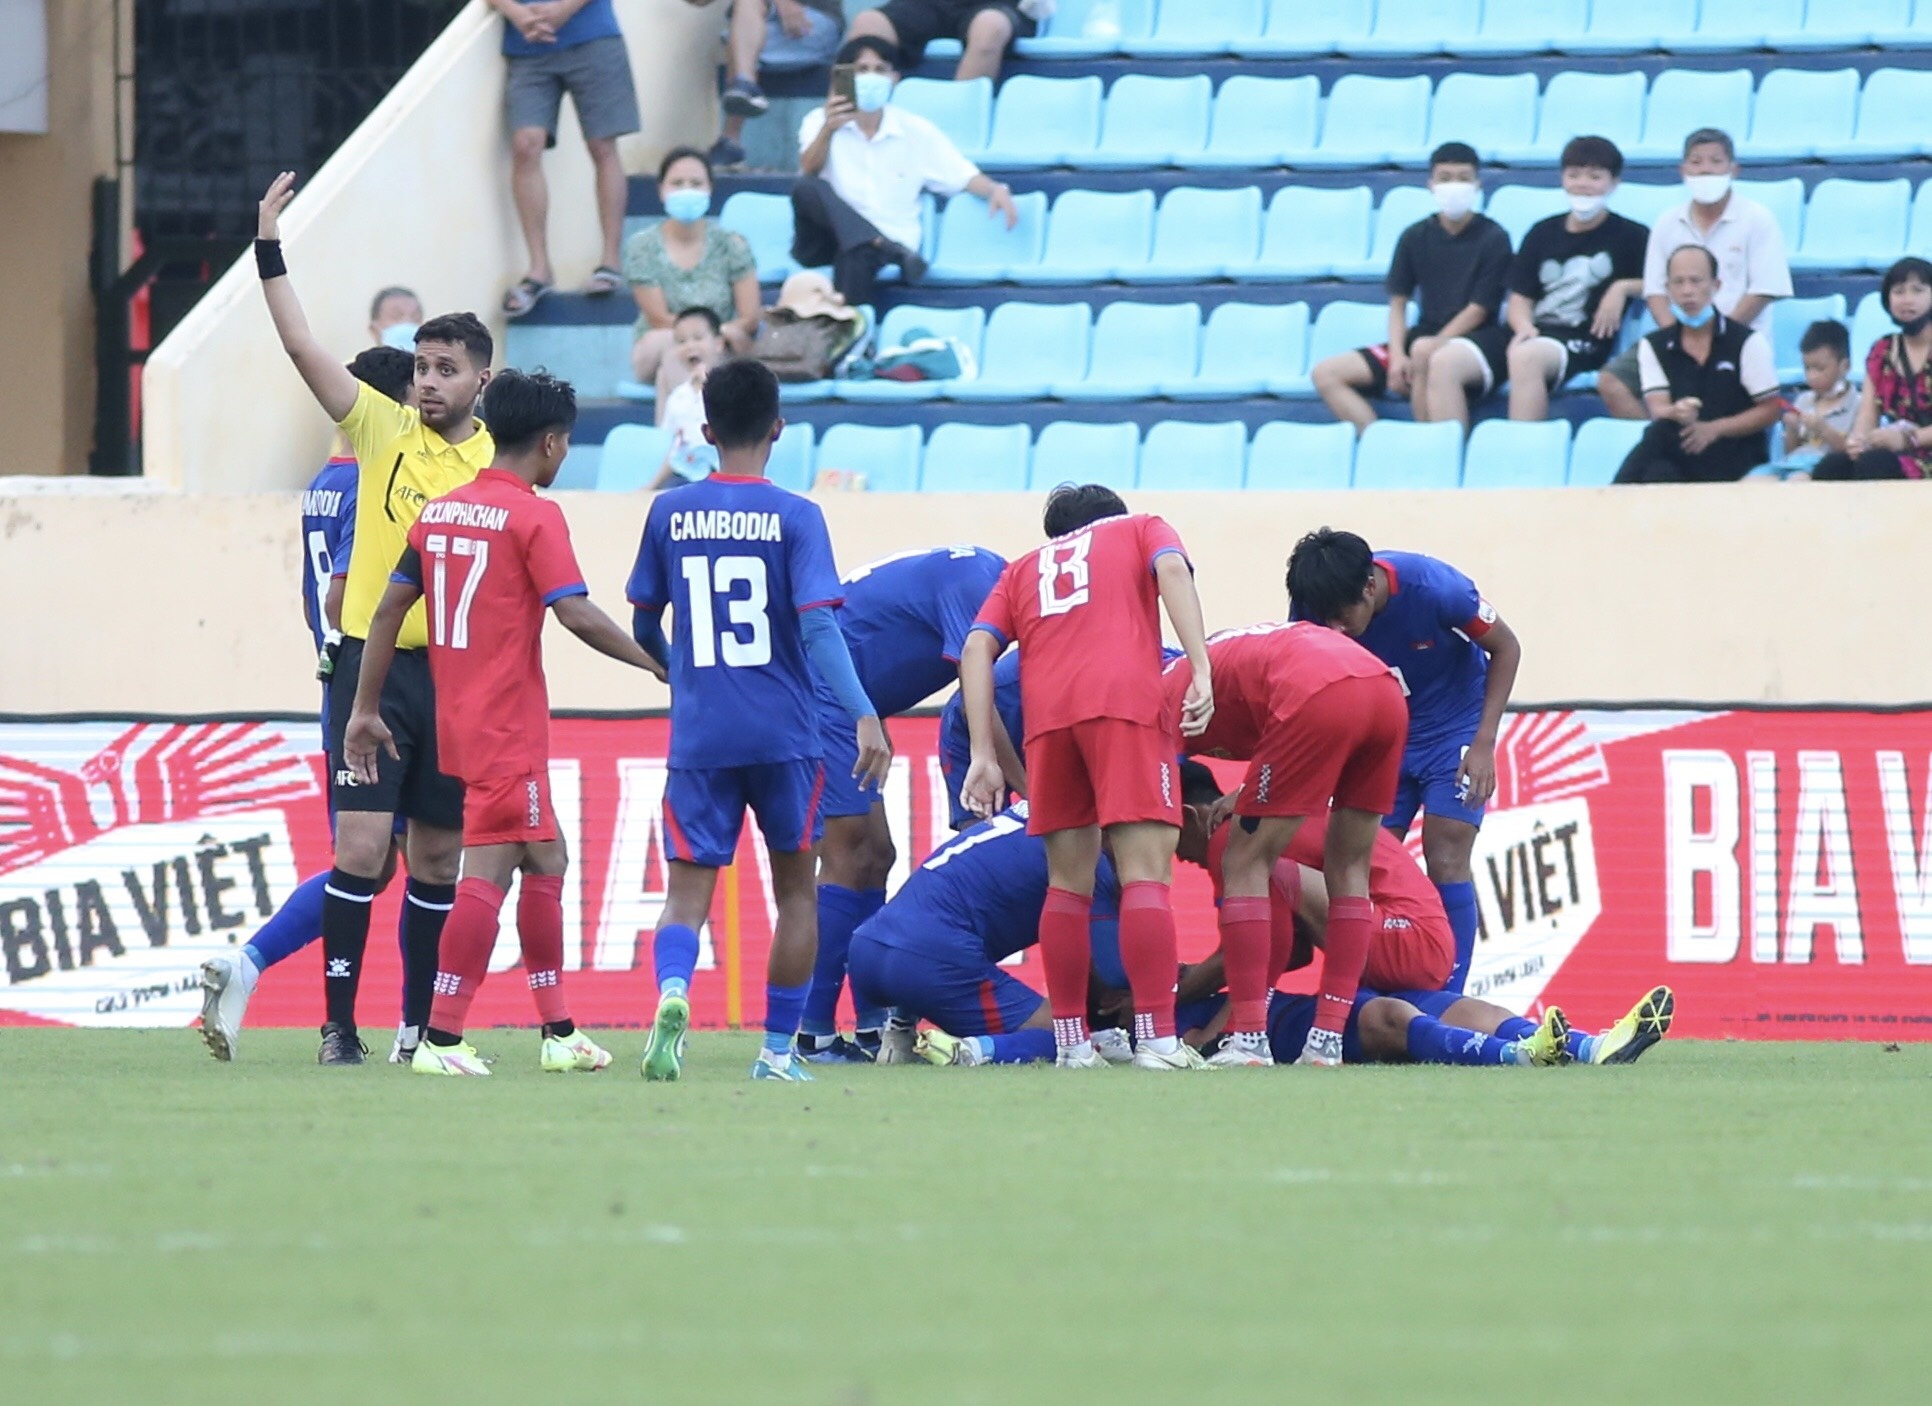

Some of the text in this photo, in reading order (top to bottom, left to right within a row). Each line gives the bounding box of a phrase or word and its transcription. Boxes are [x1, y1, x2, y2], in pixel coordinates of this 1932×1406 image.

[670, 510, 782, 543] CAMBODIA
[425, 533, 489, 649] 17
[681, 555, 772, 668] 13
[0, 832, 275, 985] BIA VIỆT
[1486, 819, 1580, 932] VIỆT
[1661, 750, 1867, 965] BIA
